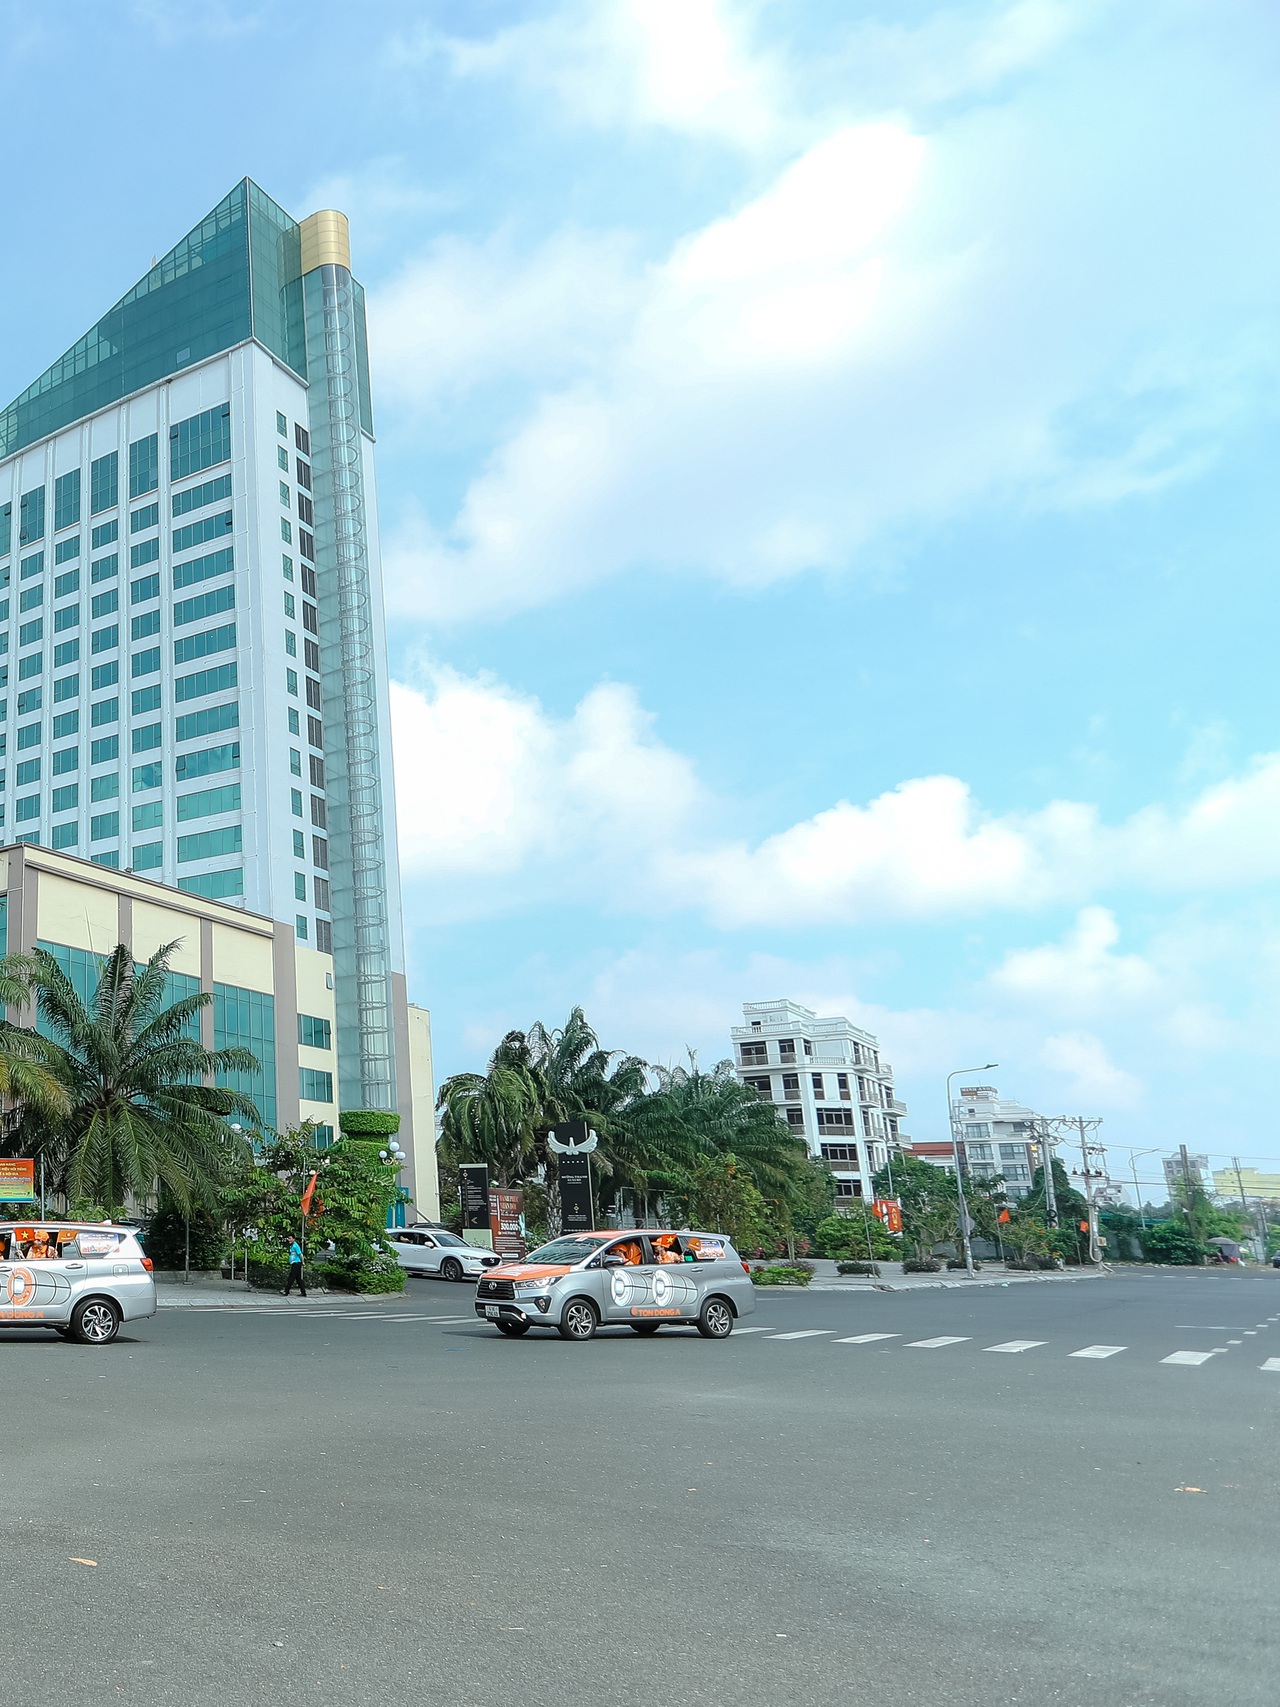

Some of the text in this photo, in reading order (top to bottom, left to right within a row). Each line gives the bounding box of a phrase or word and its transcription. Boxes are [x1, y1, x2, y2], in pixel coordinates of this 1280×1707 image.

[7, 1310, 36, 1319] DONG
[638, 1309, 654, 1317] TON
[675, 1308, 681, 1316] A
